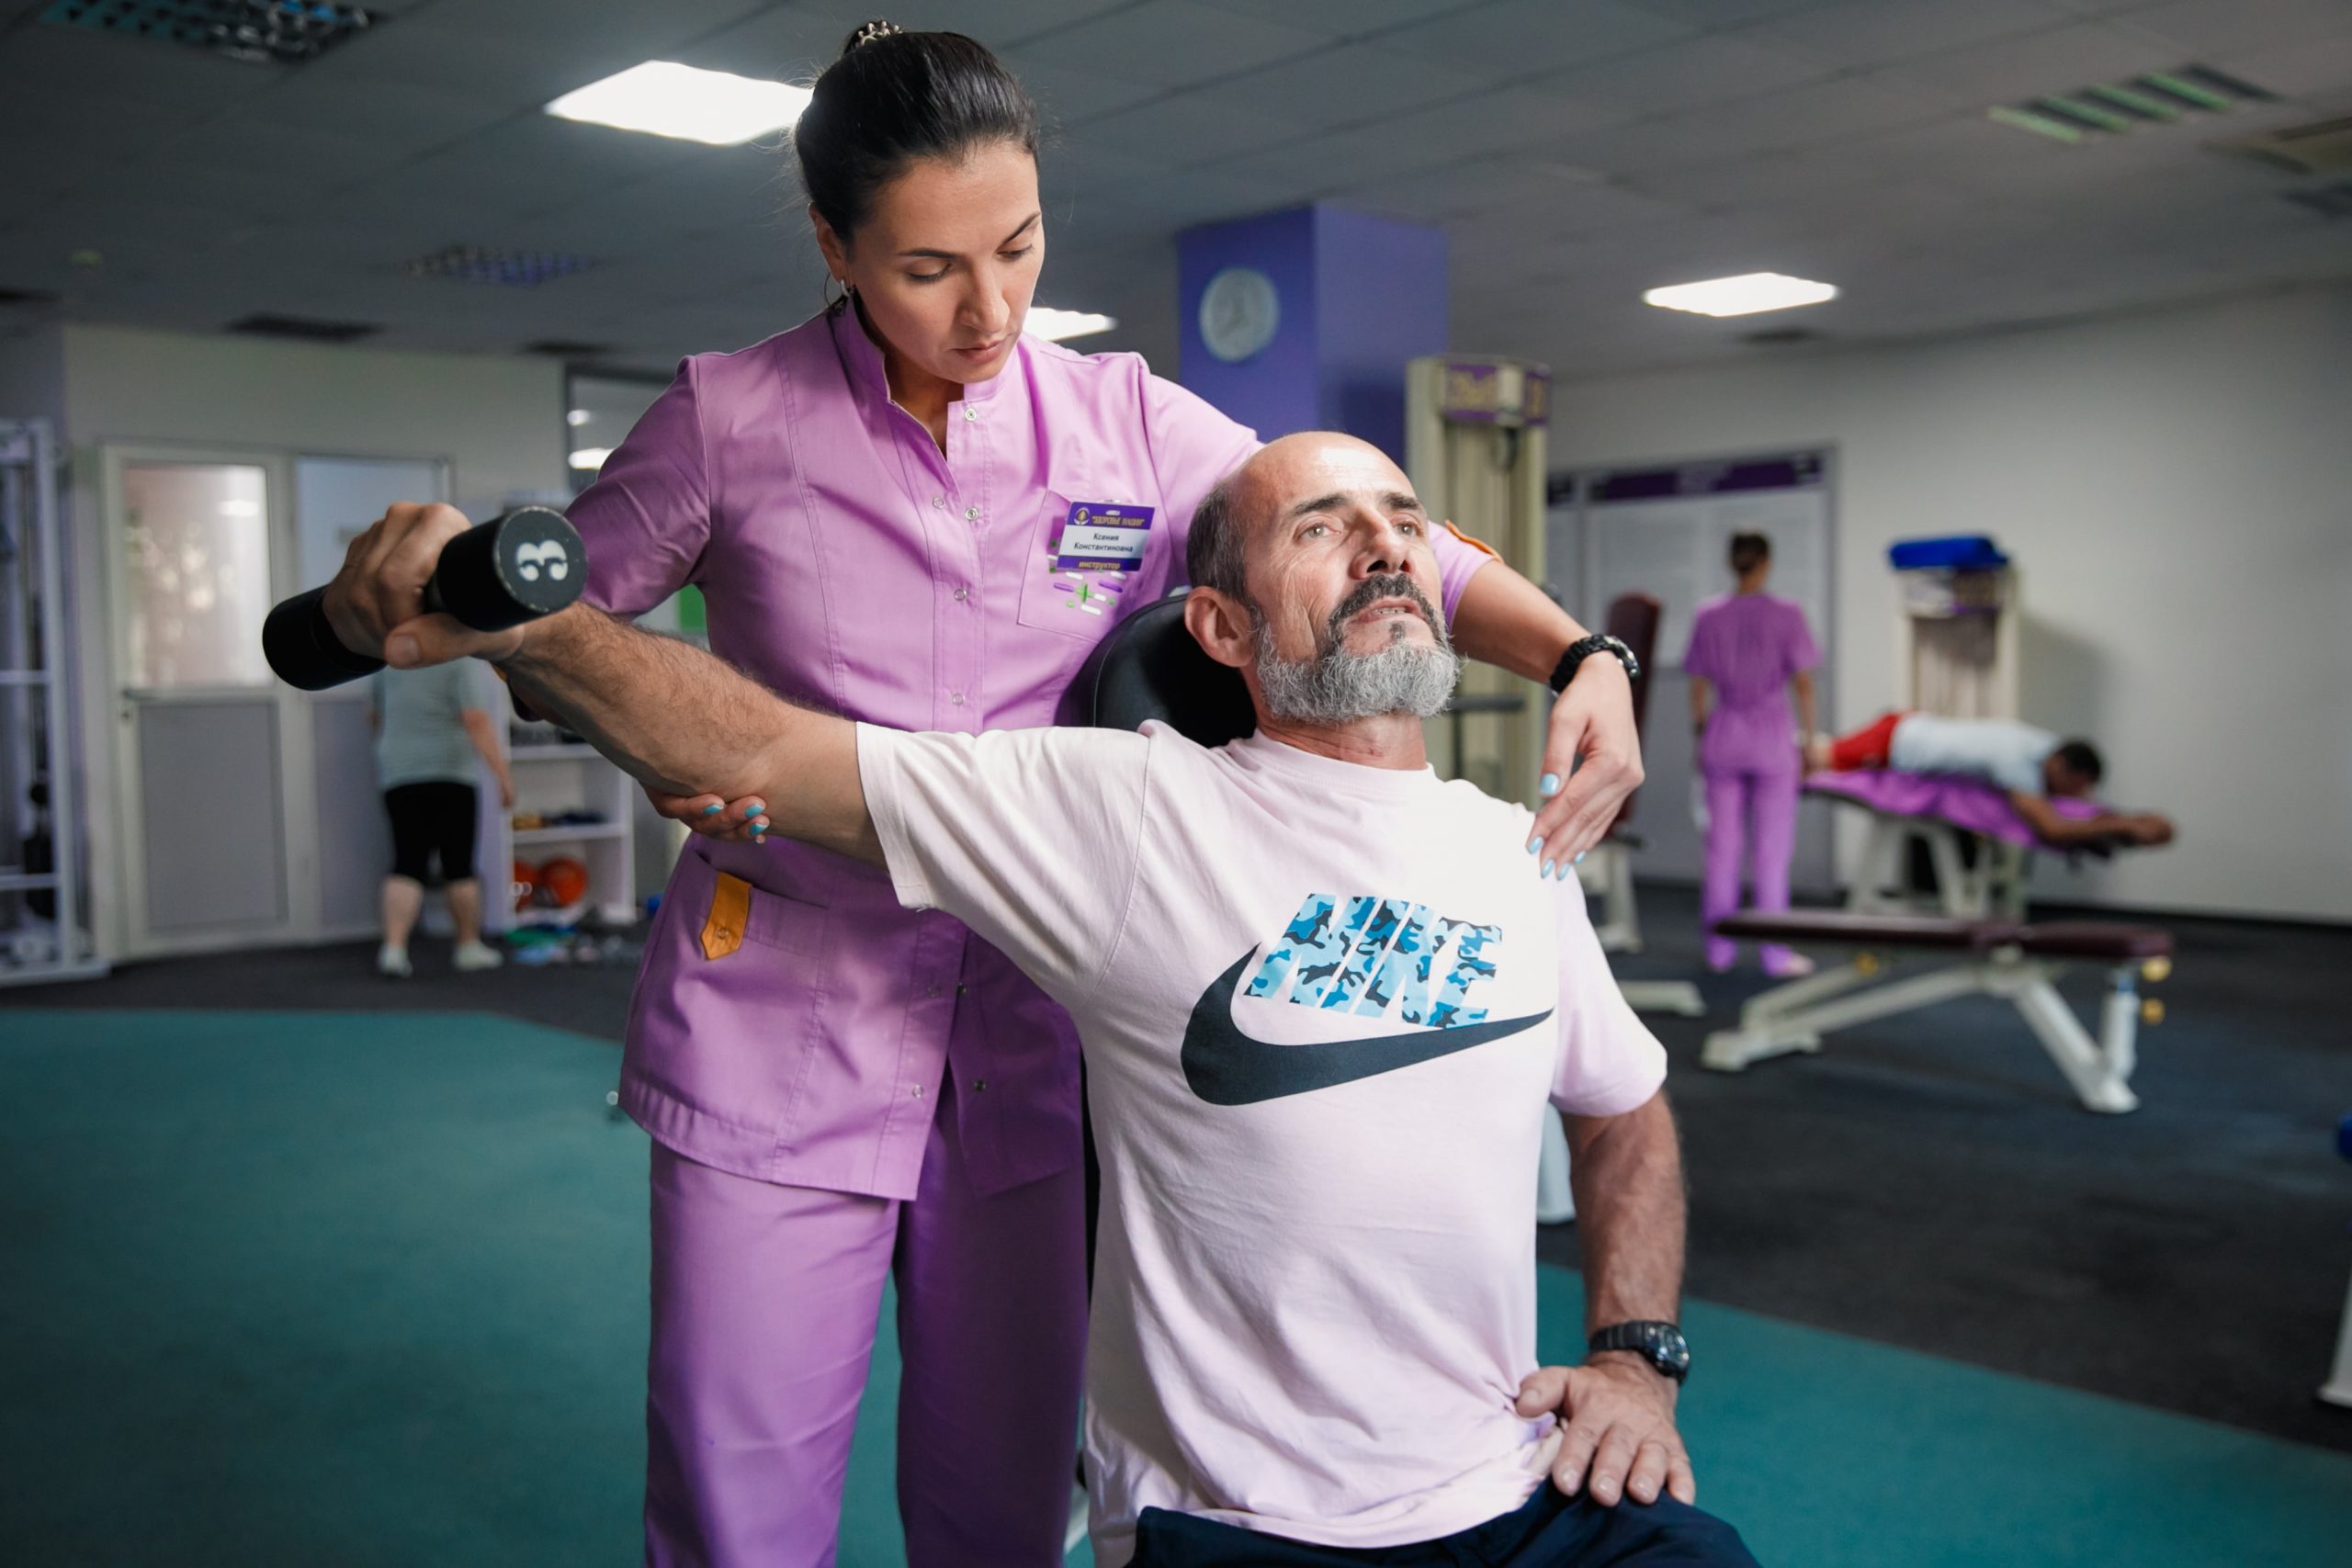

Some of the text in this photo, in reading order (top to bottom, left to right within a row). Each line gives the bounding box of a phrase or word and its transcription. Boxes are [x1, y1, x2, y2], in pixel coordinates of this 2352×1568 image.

[1073, 542, 1134, 552] Константиновна
[1092, 533, 1120, 541] Ксения
[516, 539, 569, 581] 3
[1243, 893, 1502, 1029] NIKE
